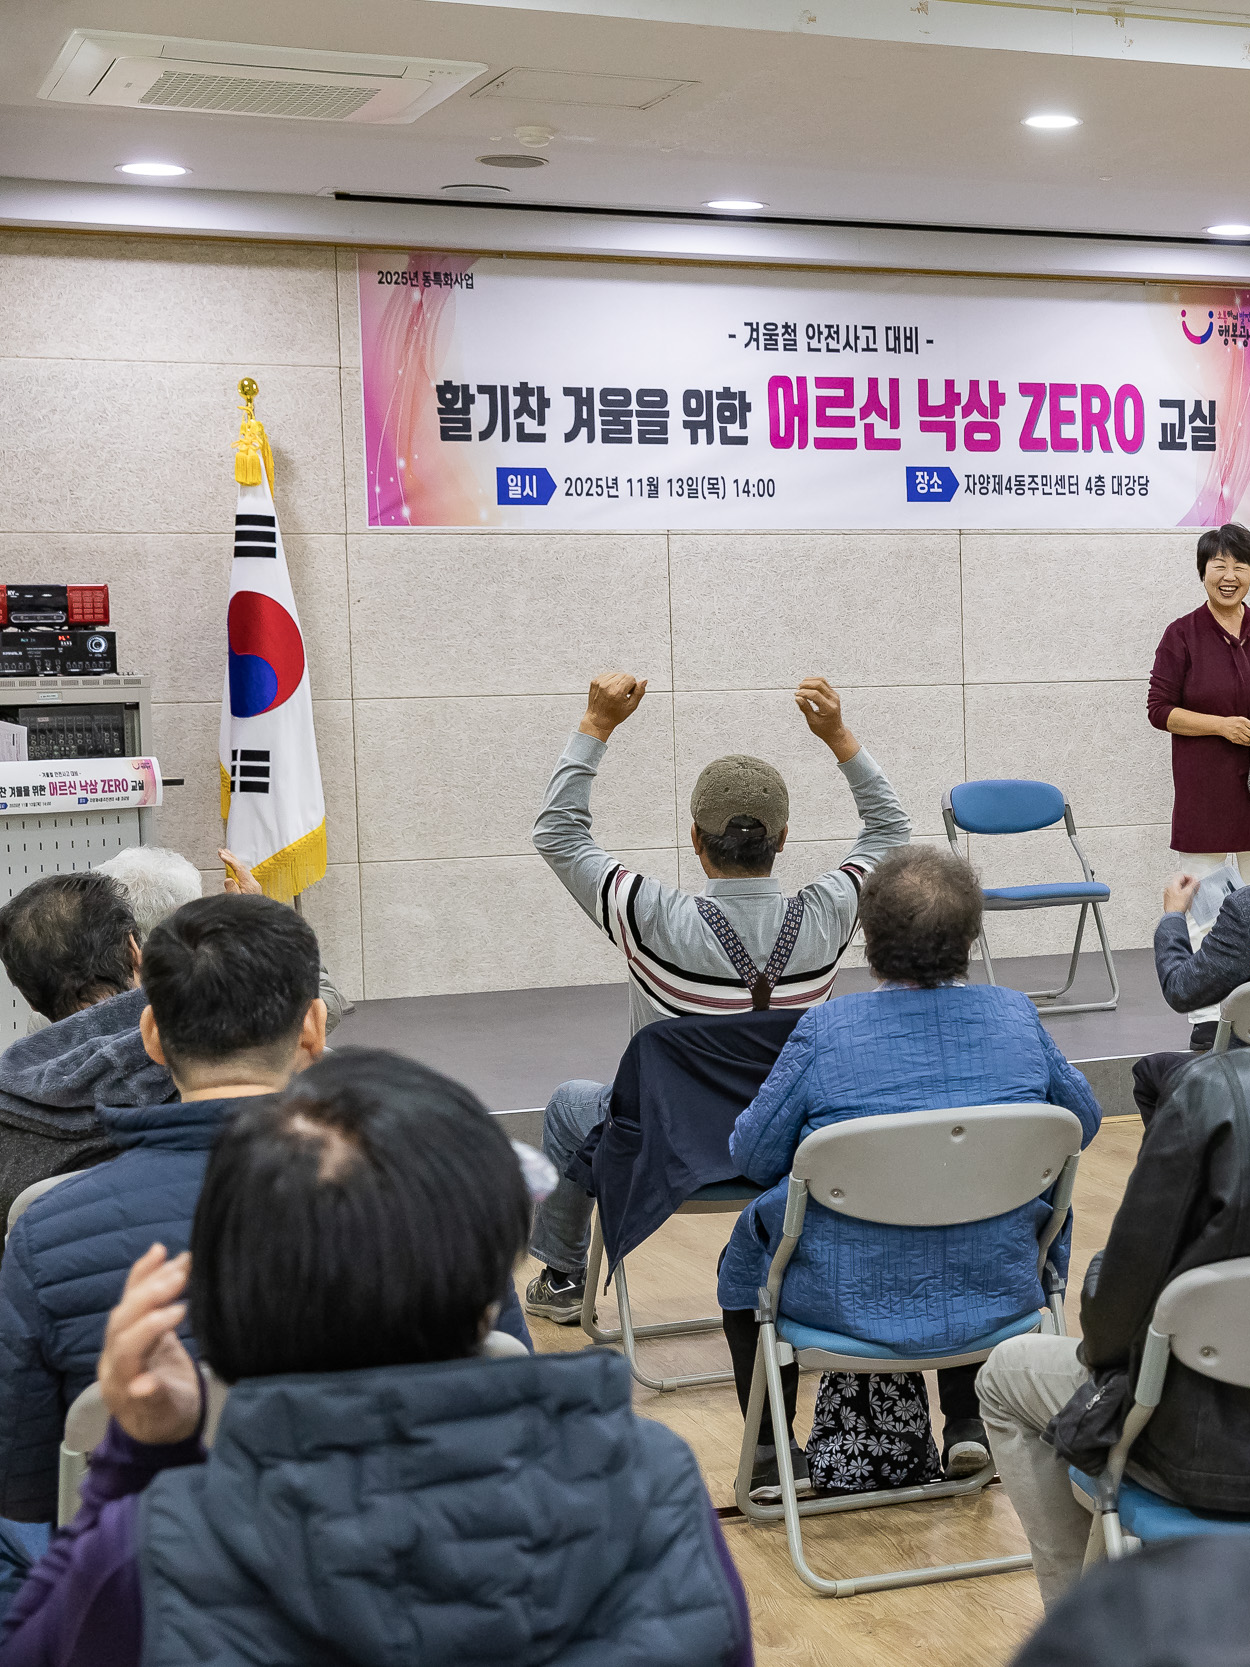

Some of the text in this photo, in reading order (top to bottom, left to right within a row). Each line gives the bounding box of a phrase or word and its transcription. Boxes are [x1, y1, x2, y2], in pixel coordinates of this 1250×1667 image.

[377, 270, 474, 289] 2025년 동특화사업
[744, 321, 798, 352] 겨울철
[805, 323, 878, 354] 안전사고
[885, 325, 919, 355] 대비
[436, 375, 1216, 454] 활기찬 겨울을 위한 어르신 낙상 ZERO 교실
[507, 474, 537, 499] 일시
[564, 476, 776, 500] 2025년 11월 13일(목) 14:00
[915, 471, 943, 494] 장소
[964, 474, 1150, 496] 자양제4동주민센터 4층 대강당
[32, 785, 46, 797] 위한
[79, 779, 98, 794] 낙상
[100, 778, 129, 794] ZERO
